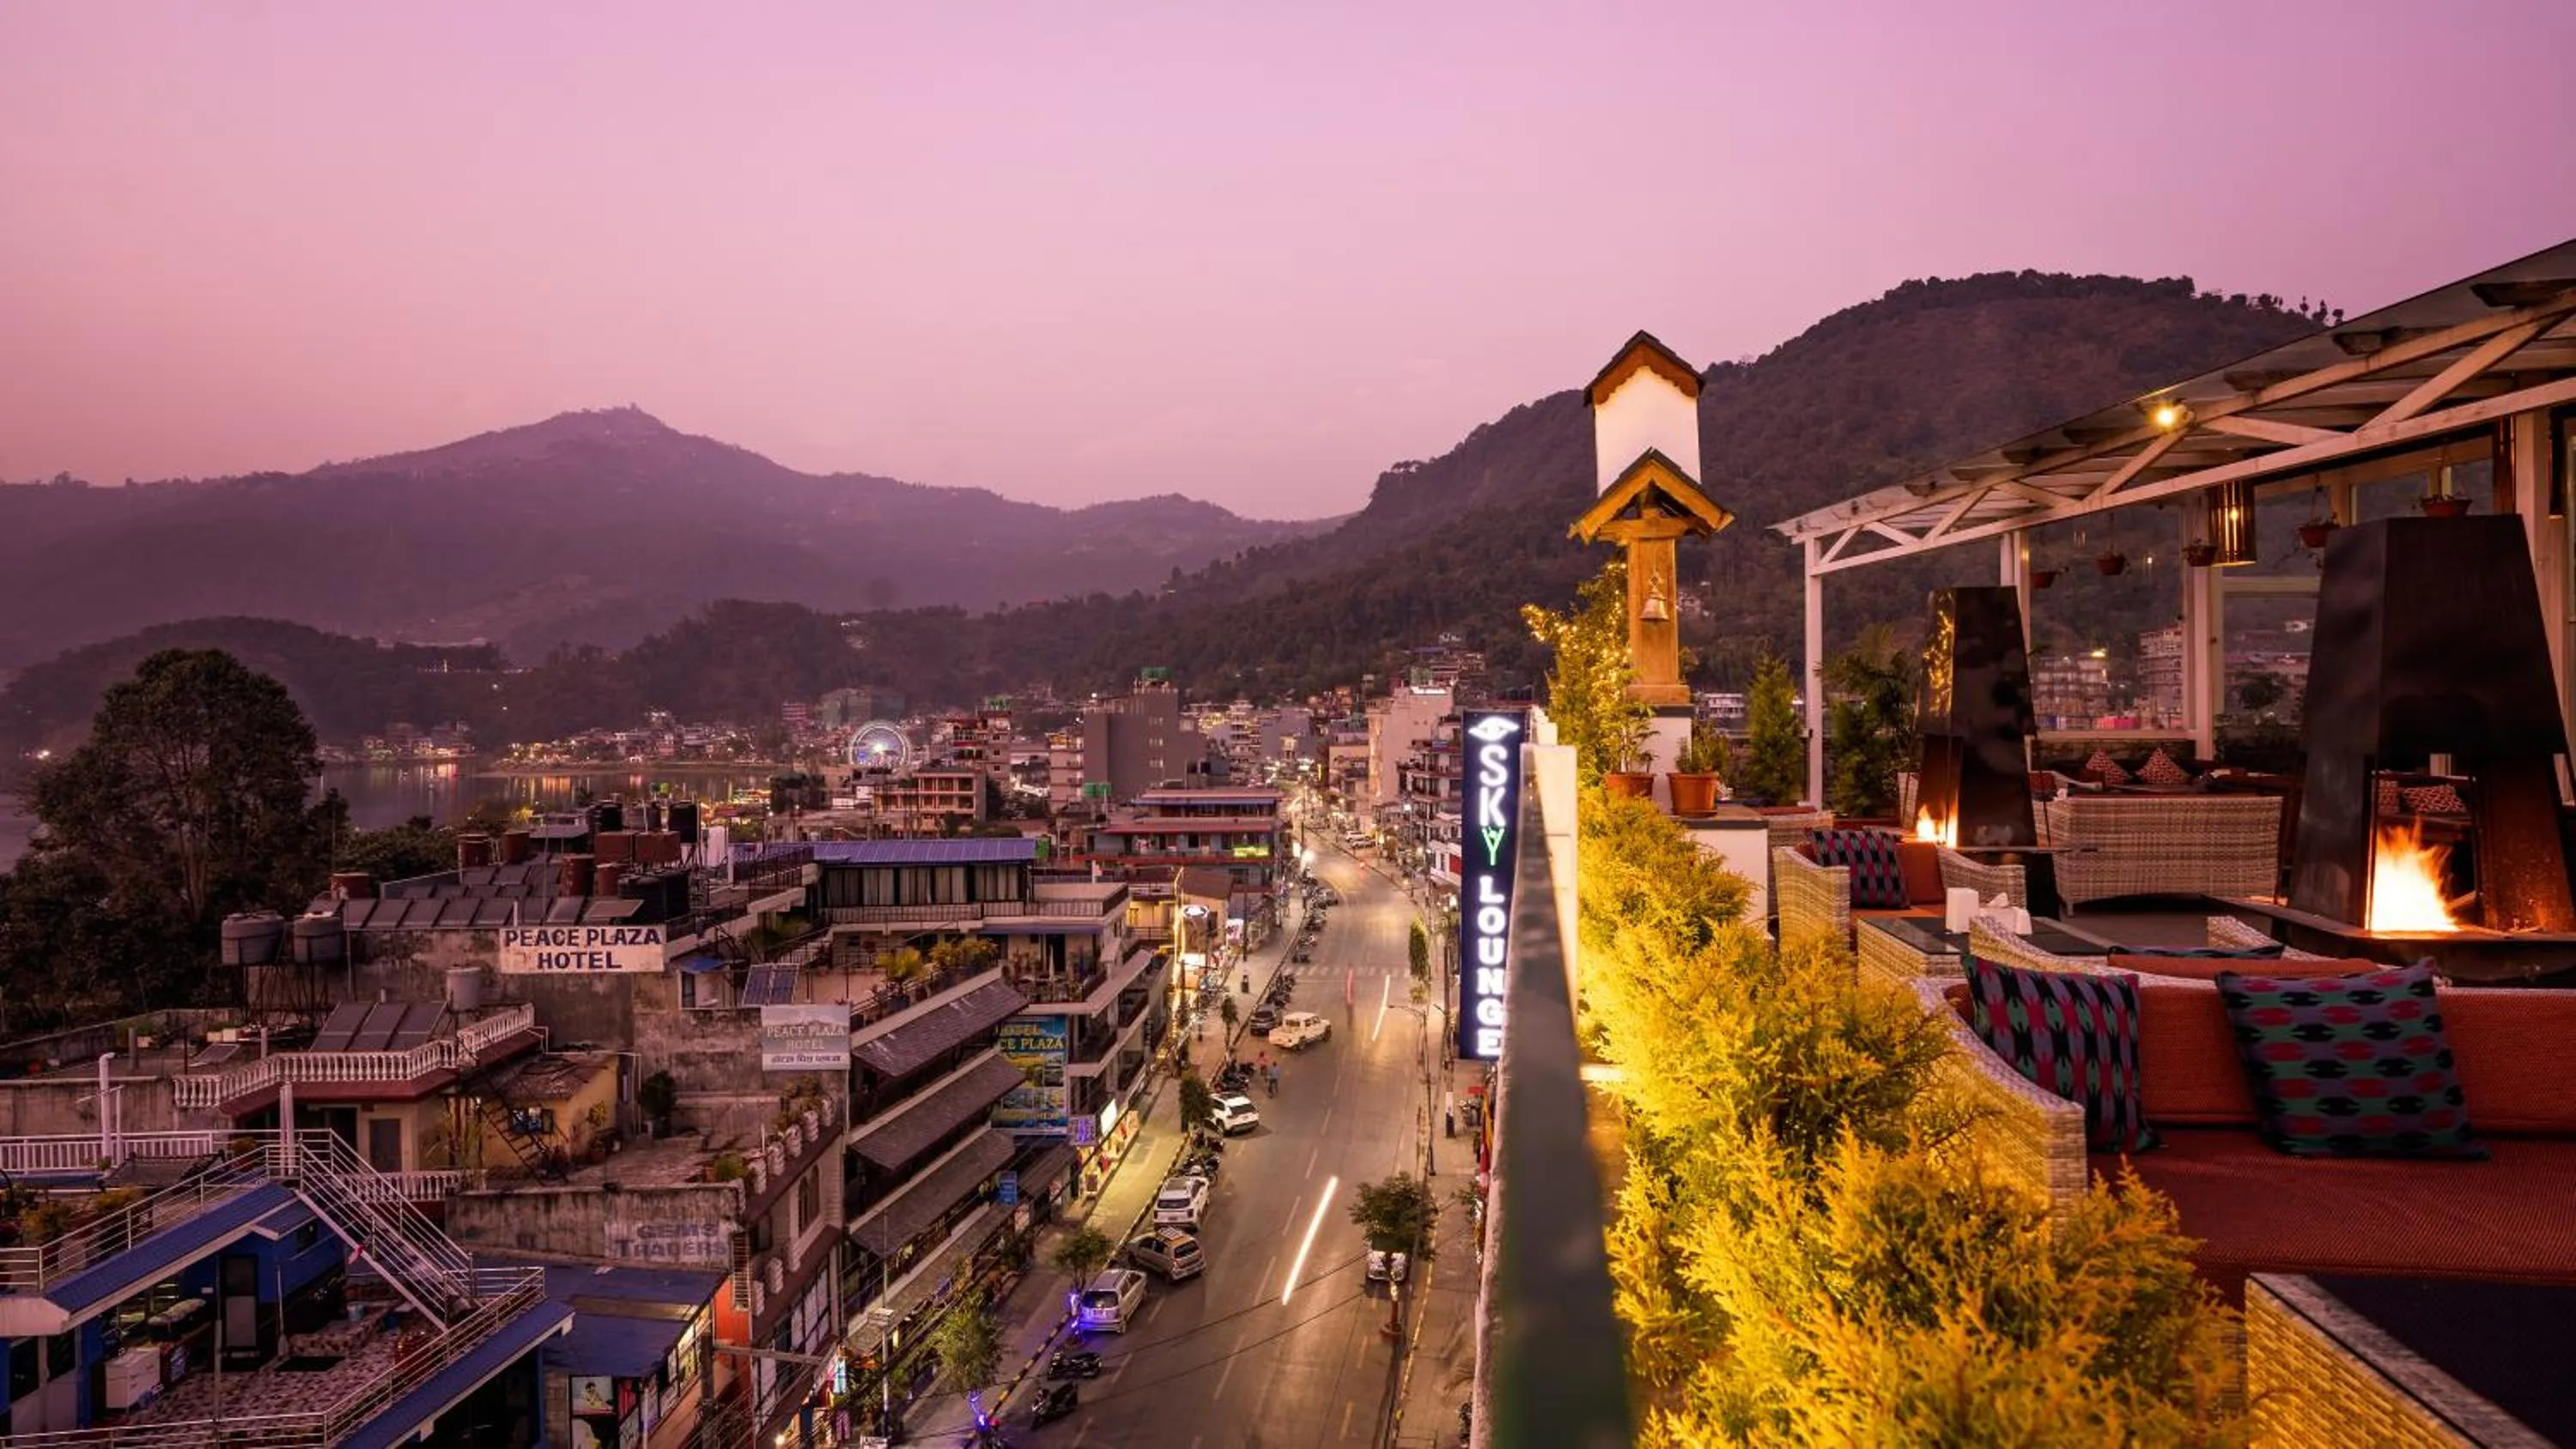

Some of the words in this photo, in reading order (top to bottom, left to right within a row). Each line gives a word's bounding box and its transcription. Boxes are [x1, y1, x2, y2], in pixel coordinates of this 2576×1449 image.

[1479, 744, 1507, 866] SKY
[505, 929, 580, 947] PEACE
[586, 929, 660, 946] PLAZA
[538, 952, 623, 969] HOTEL
[1476, 876, 1506, 1055] LOUNGE
[767, 1026, 805, 1039] PEACE
[808, 1024, 845, 1038] PLAZA
[786, 1039, 825, 1051] HOTEL
[1020, 1038, 1065, 1049] PLAZA
[637, 1223, 719, 1238] GEMS
